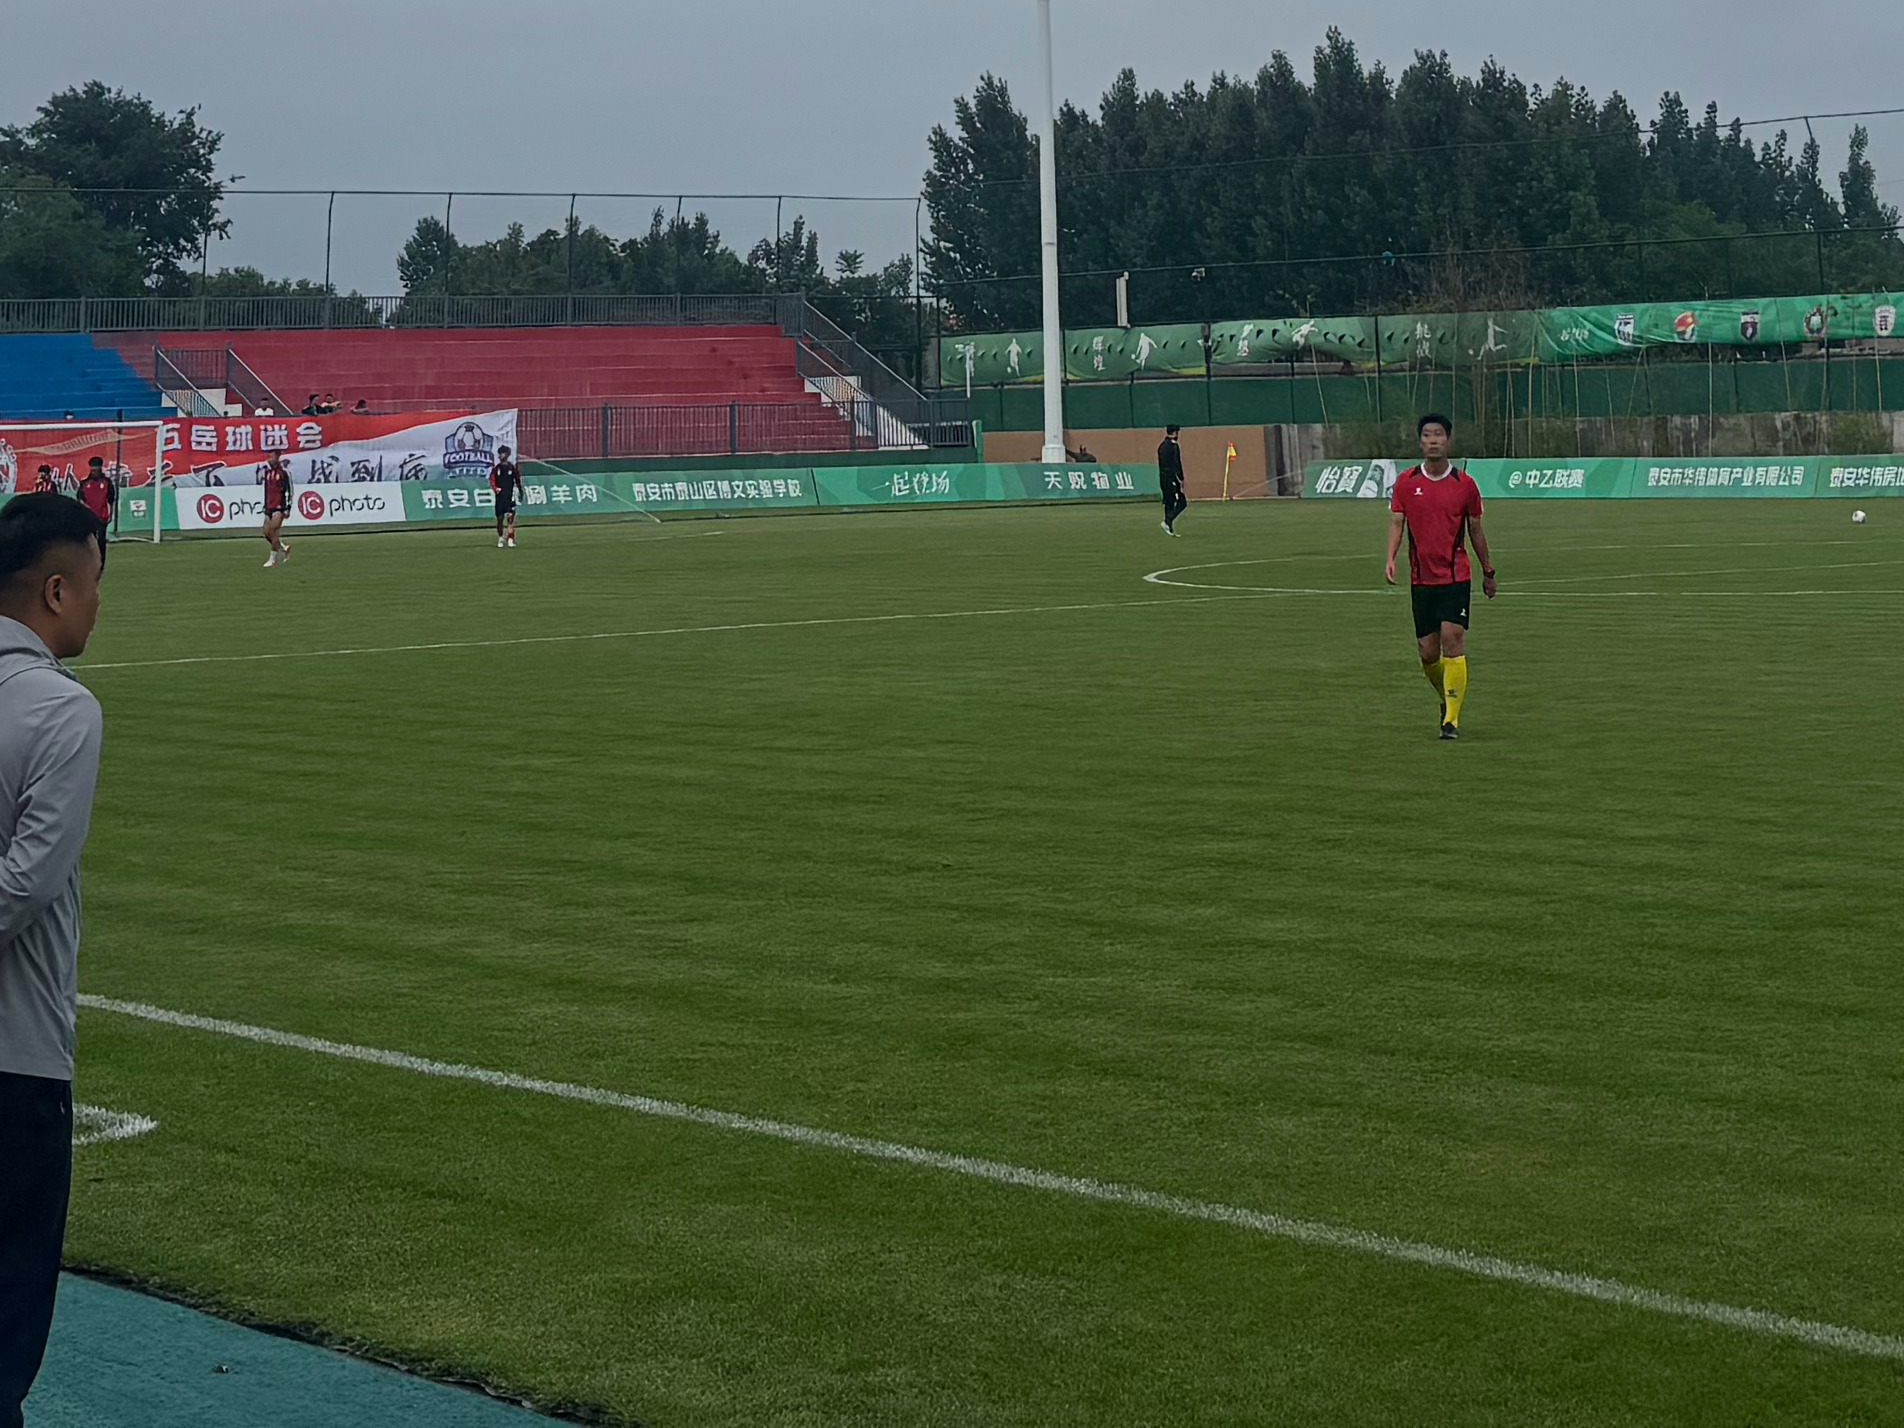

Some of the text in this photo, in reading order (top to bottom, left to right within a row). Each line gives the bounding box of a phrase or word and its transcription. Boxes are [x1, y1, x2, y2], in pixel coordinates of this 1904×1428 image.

[1315, 465, 1364, 495] 怡寶
[329, 494, 386, 518] photo
[421, 483, 598, 509] 泰安白涮羊肉
